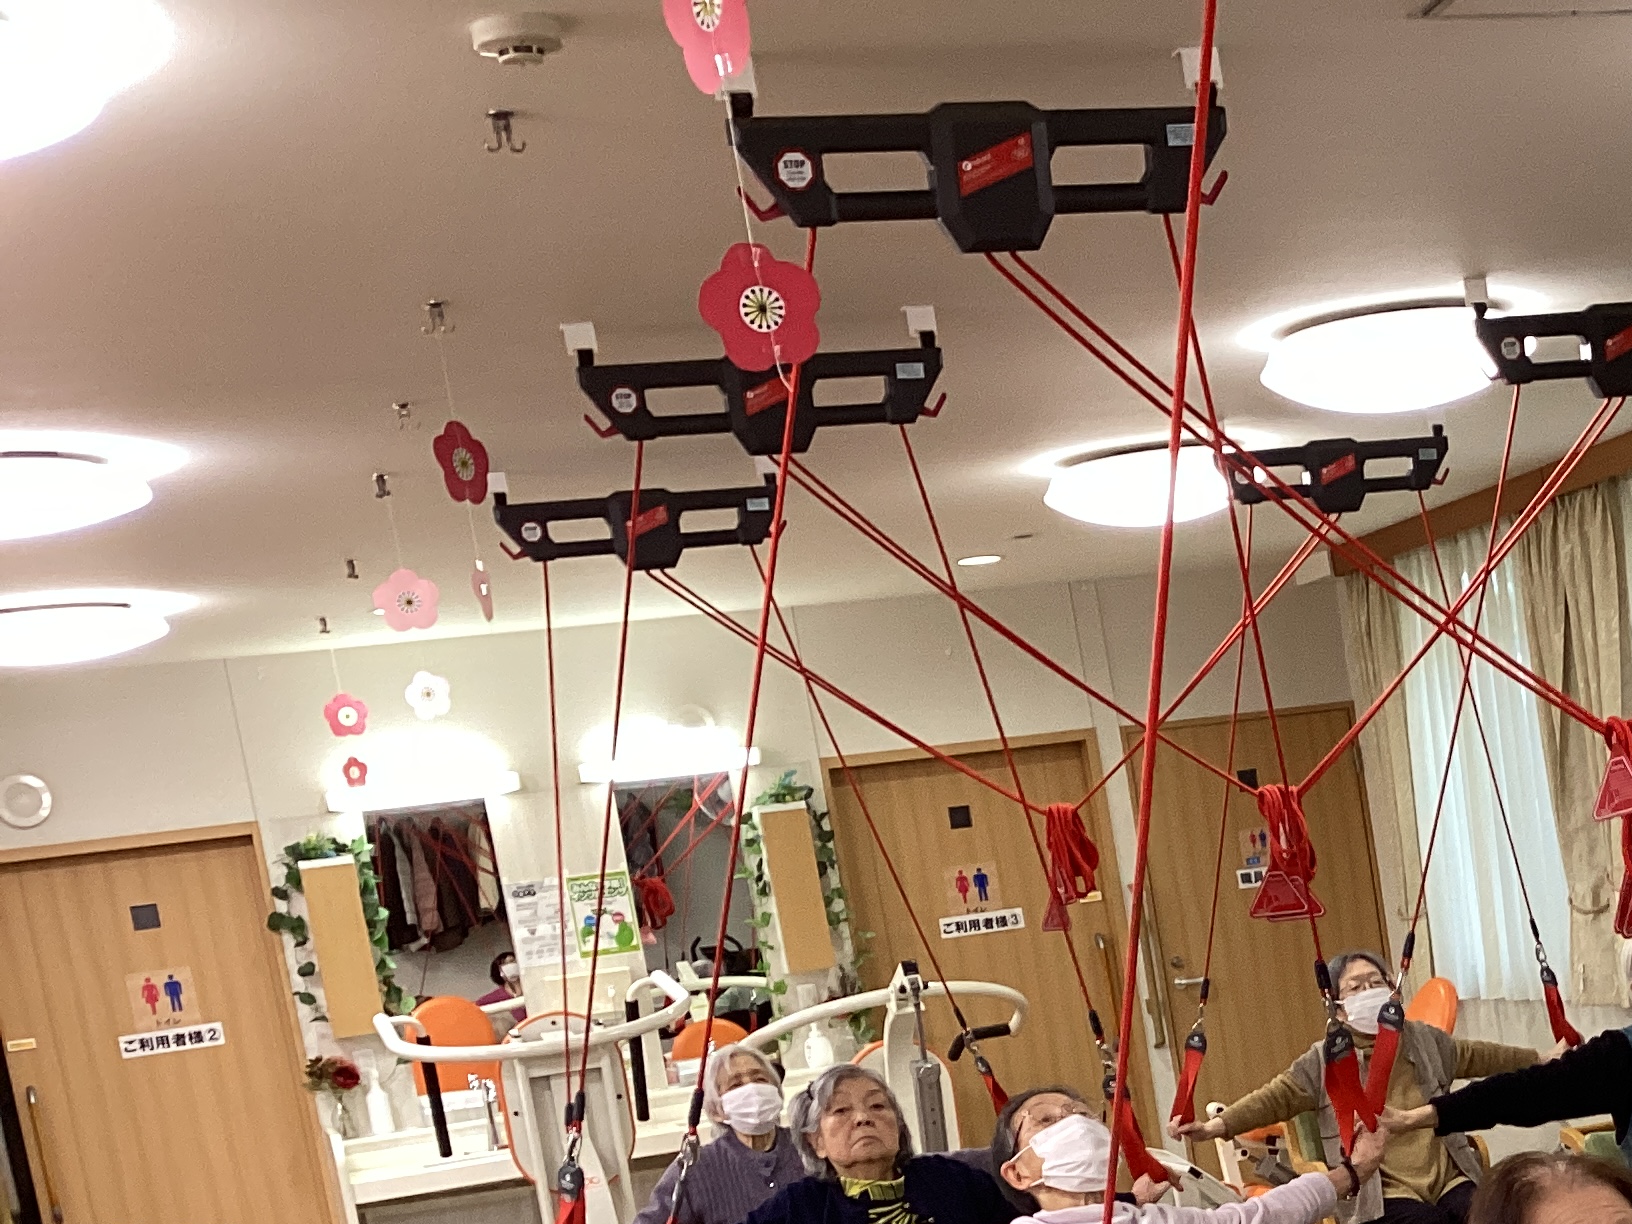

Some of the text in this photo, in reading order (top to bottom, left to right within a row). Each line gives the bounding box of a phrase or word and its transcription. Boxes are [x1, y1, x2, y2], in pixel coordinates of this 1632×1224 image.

[783, 159, 806, 169] STOP
[156, 1018, 182, 1028] トイレ
